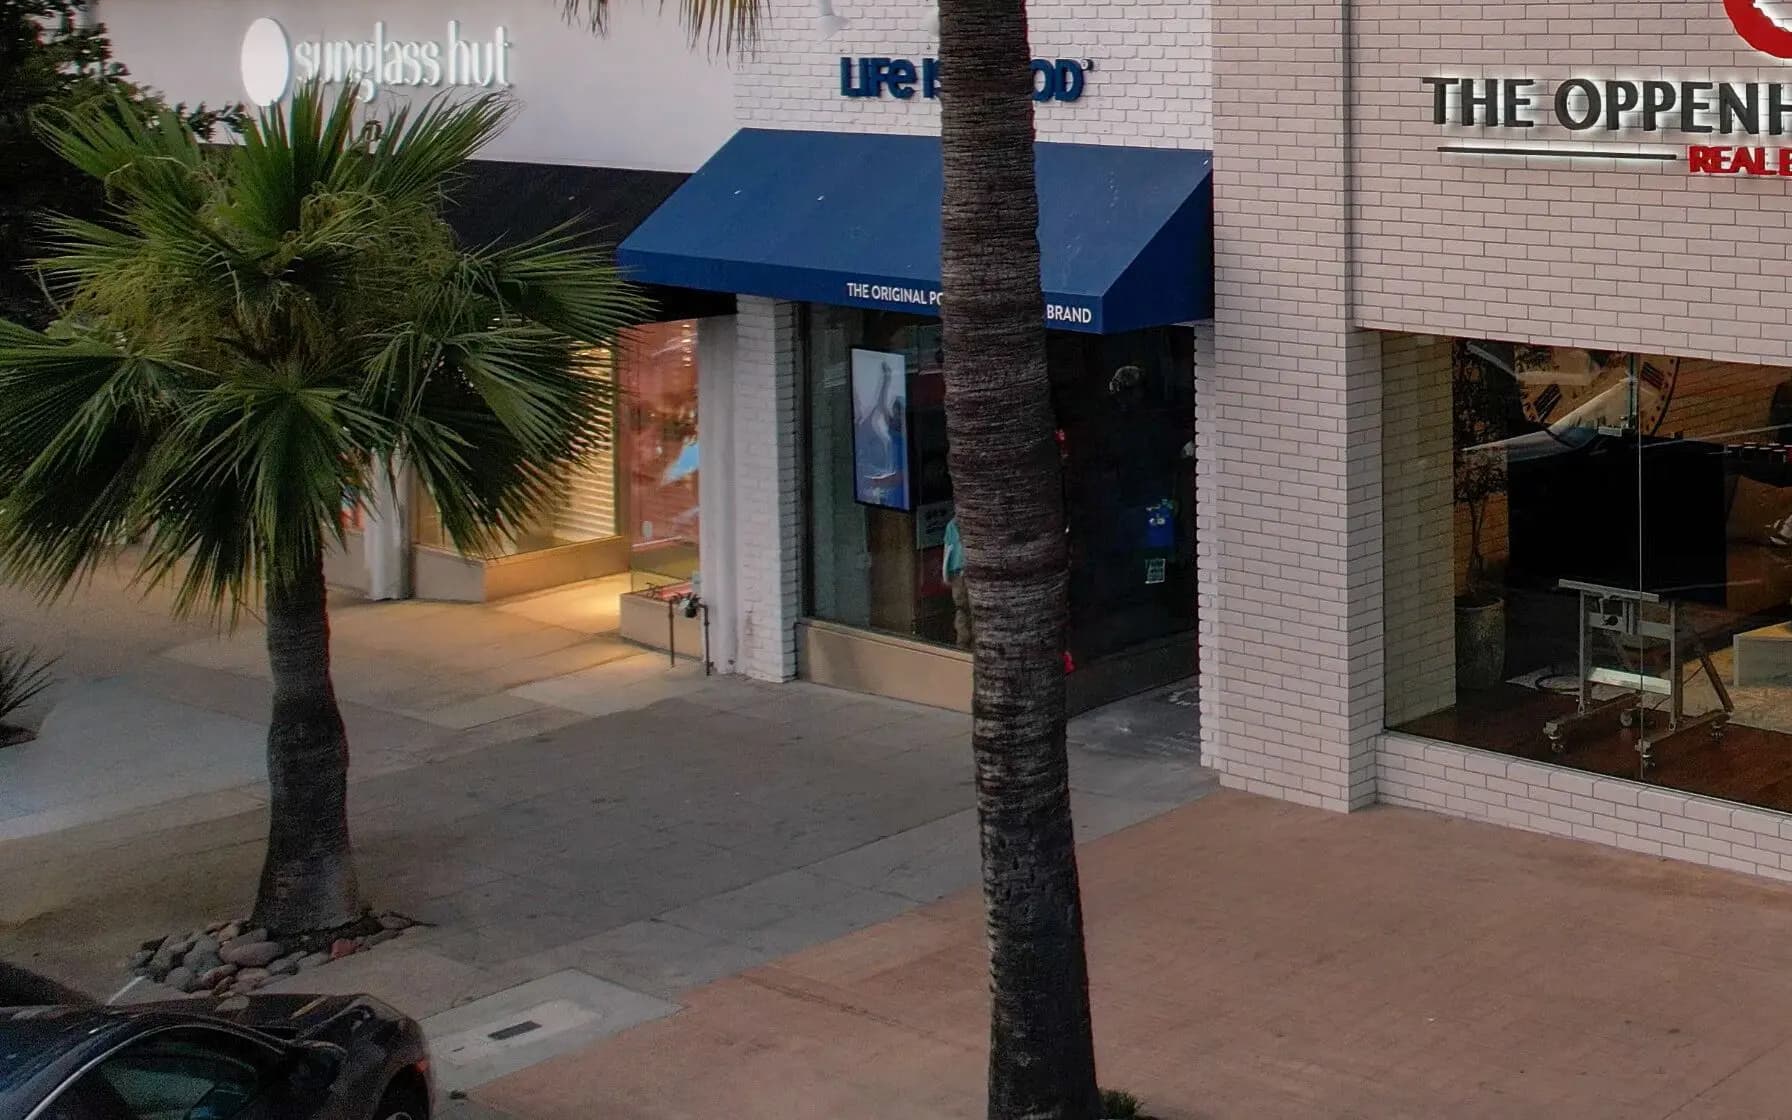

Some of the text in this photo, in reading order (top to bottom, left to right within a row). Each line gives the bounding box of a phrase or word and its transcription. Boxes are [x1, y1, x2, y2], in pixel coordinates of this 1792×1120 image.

[295, 20, 513, 103] sunglass hut
[1423, 77, 1534, 127] THE
[847, 282, 869, 298] THE
[872, 284, 927, 305] ORIGINAL
[1046, 304, 1092, 324] BRAND
